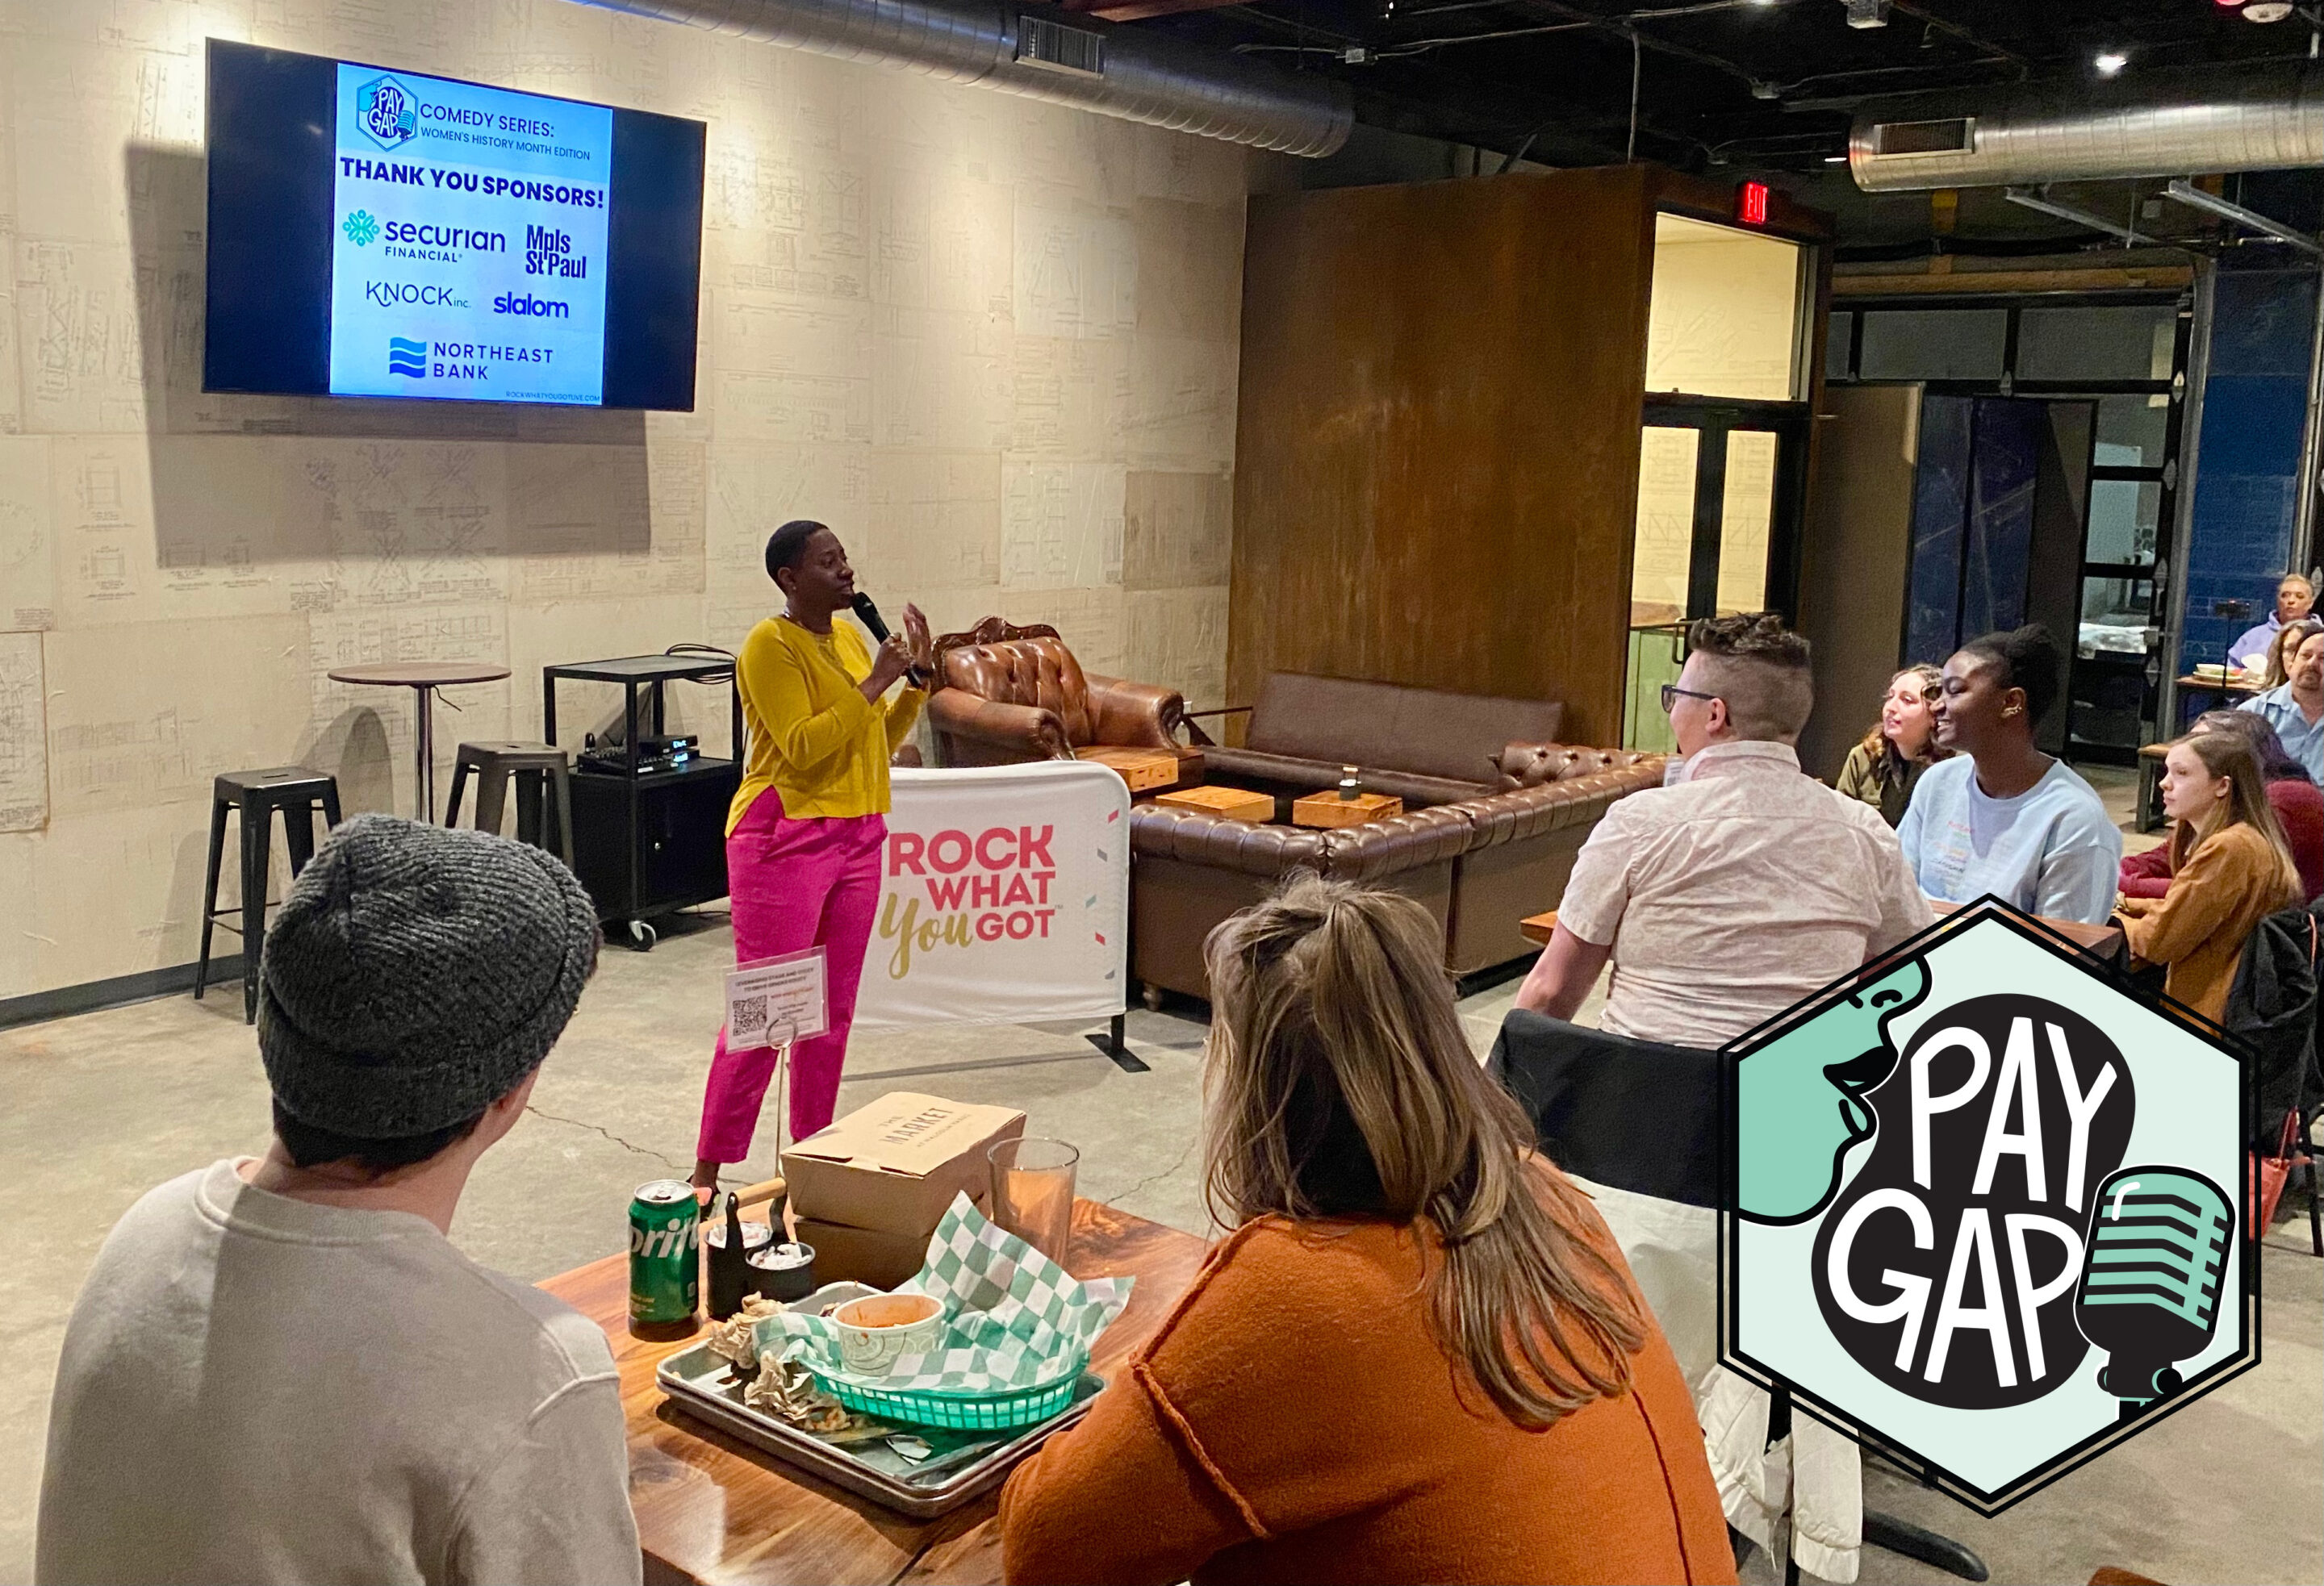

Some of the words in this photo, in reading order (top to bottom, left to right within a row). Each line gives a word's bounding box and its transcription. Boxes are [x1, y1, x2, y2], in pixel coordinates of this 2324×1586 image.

[378, 89, 403, 116] PAY
[369, 108, 399, 136] GAP
[420, 104, 494, 127] COMEDY
[499, 116, 554, 137] SERIES:
[420, 127, 469, 143] WOMEN'S
[472, 134, 513, 149] HISTORY
[516, 141, 551, 155] MONTH
[554, 148, 590, 161] EDITION
[340, 157, 424, 186] THANK
[430, 169, 478, 192] YOU
[483, 176, 604, 209] SPONSORS!
[385, 220, 506, 253] securian
[526, 223, 571, 260] Mpls
[525, 251, 545, 275] St
[548, 253, 587, 279] Paul
[366, 281, 454, 307] KNOCK
[493, 291, 569, 319] slalom
[433, 342, 554, 363] NORTHEAST
[433, 363, 488, 380] BANK
[888, 824, 1055, 877] ROCK
[926, 870, 1056, 912] WHAT
[879, 892, 973, 980] You
[975, 909, 1055, 941] GOT
[878, 1108, 954, 1146] MARKET
